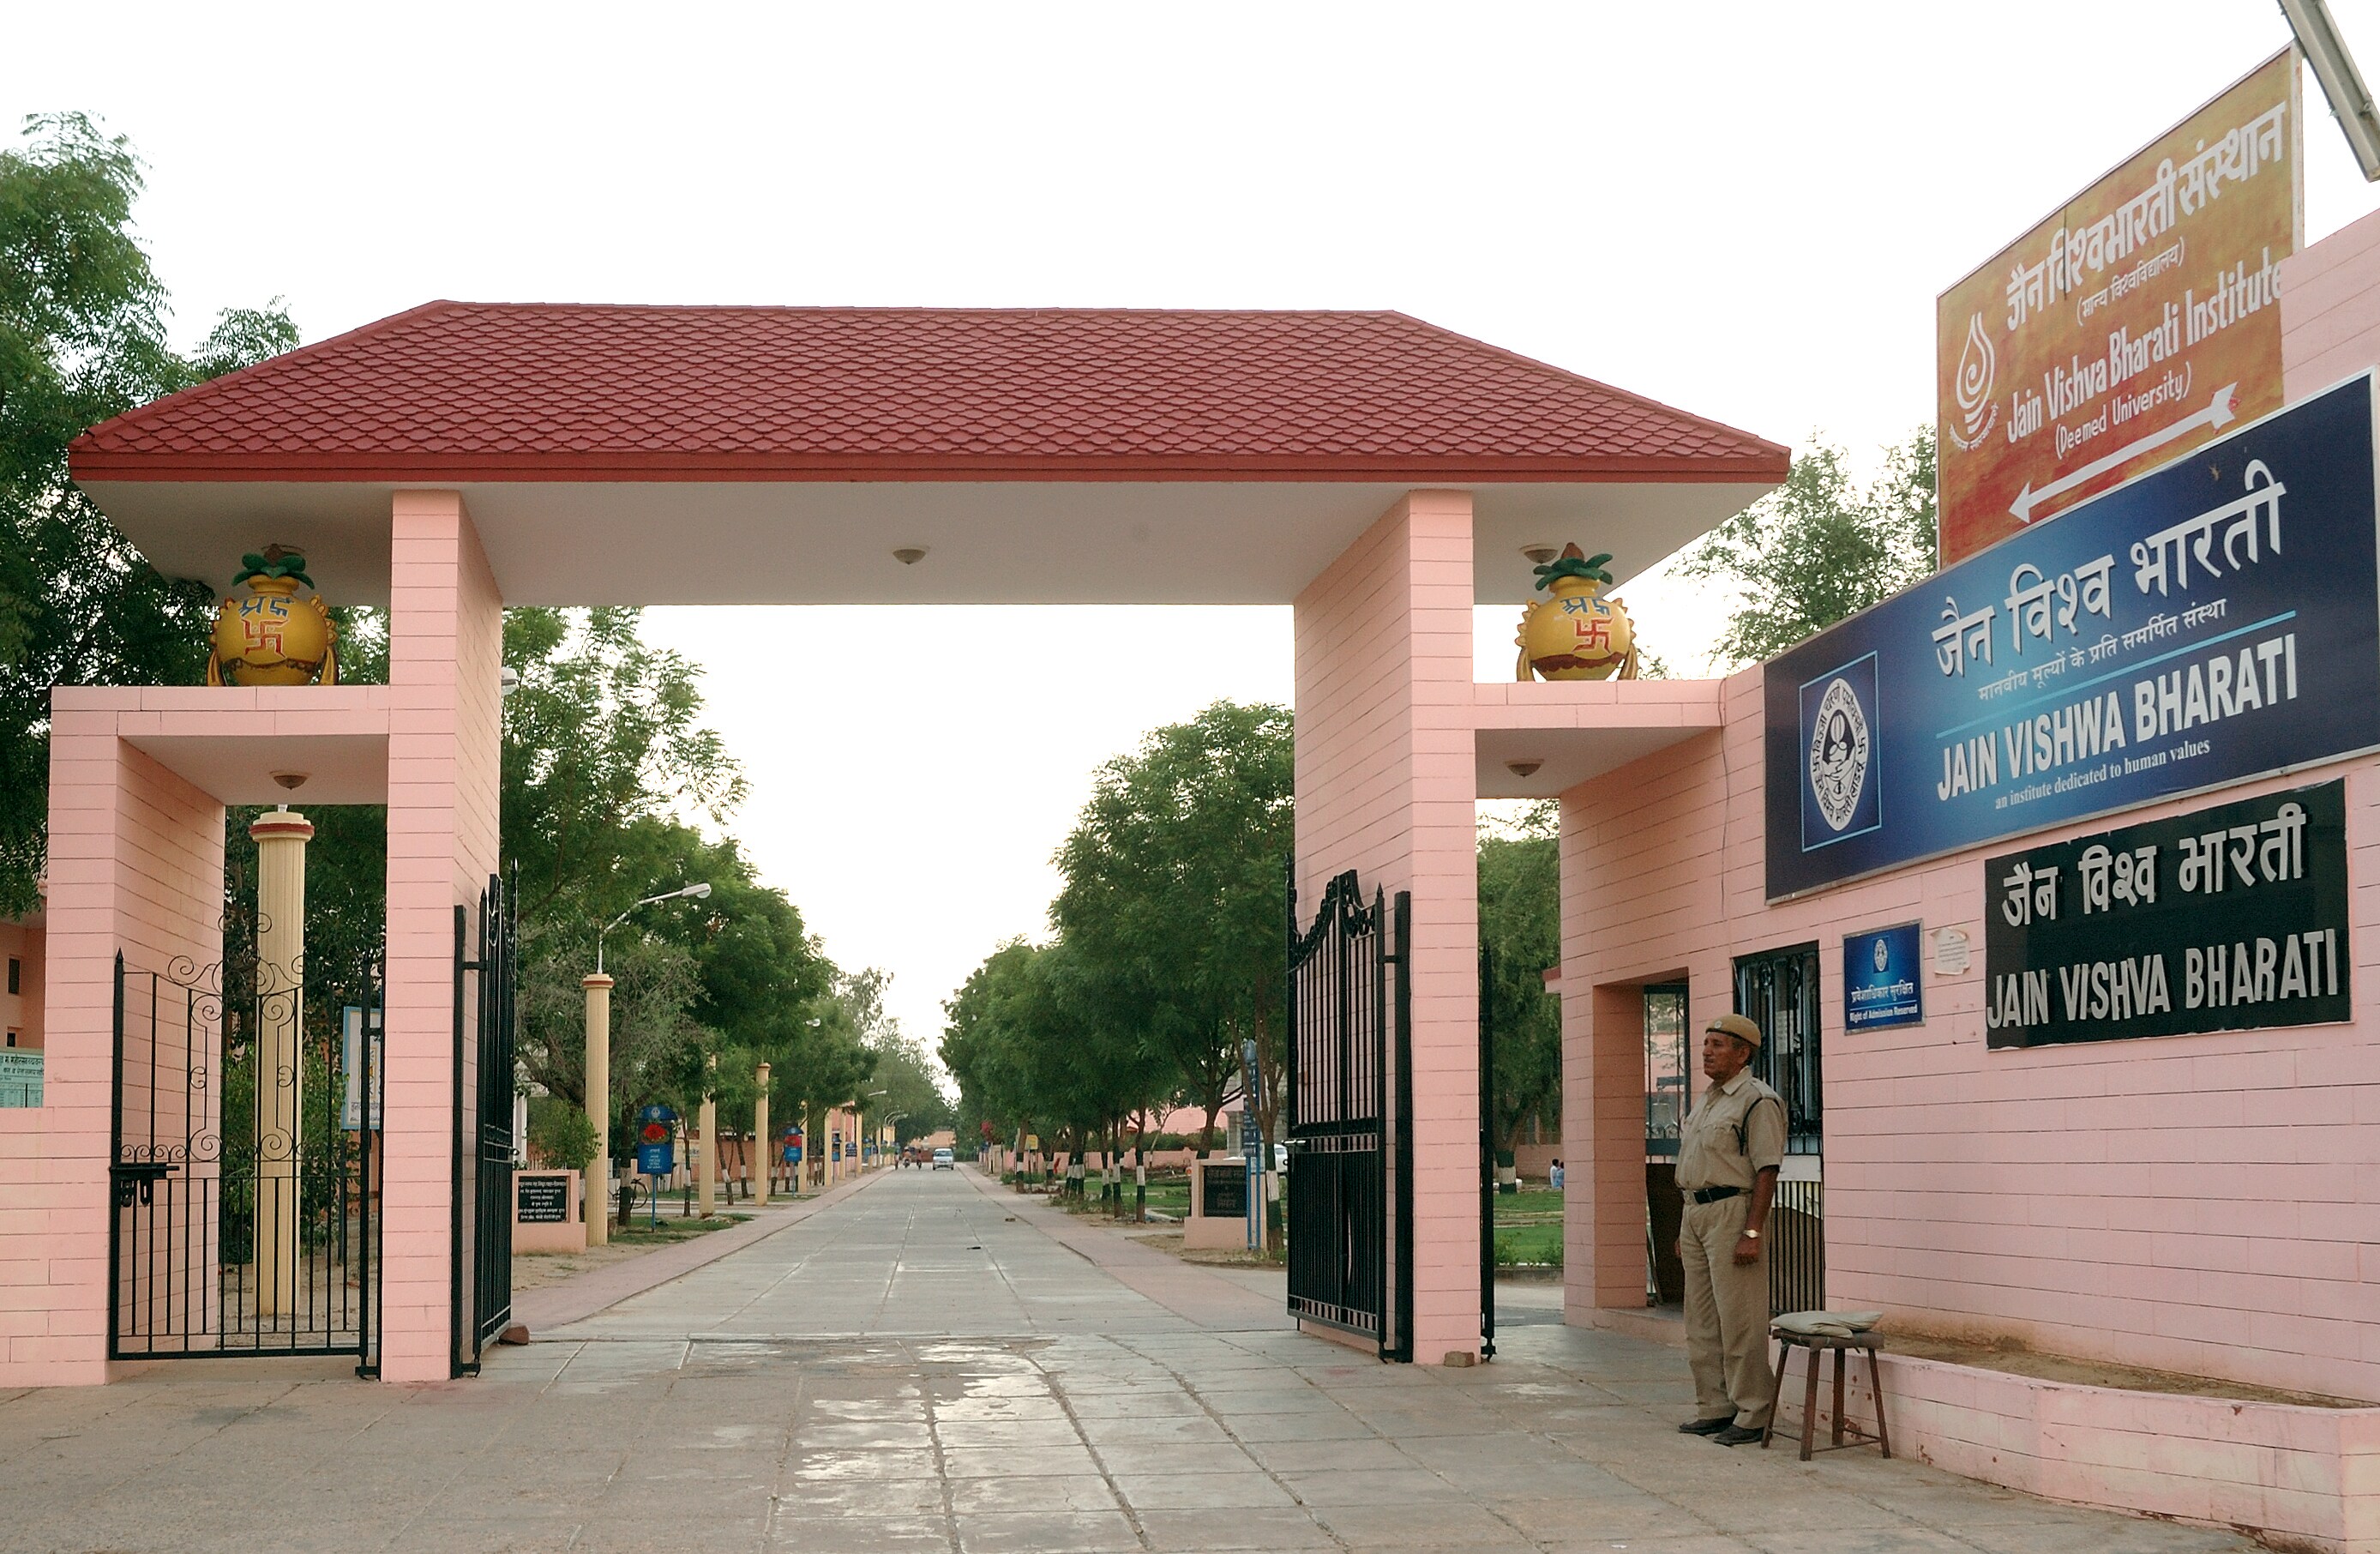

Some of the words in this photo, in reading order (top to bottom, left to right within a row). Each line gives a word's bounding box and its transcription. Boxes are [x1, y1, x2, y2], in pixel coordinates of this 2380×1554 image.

[2006, 259, 2046, 331] जैन
[2178, 100, 2286, 216] संस्थान
[2007, 388, 2042, 443] Jain
[2045, 355, 2107, 420] Vishva
[2109, 301, 2179, 388] Bharati
[2185, 246, 2282, 346] Institute
[2055, 413, 2107, 460] (Deemed
[2112, 361, 2191, 425] University)
[1931, 596, 1996, 678] जैन
[2004, 553, 2116, 655] विश्व
[2131, 458, 2287, 598] भारती
[1978, 671, 2028, 701] मानवीय
[2032, 652, 2066, 690] मूल्यों
[2069, 653, 2085, 669] के
[2089, 635, 2118, 664] प्रति
[2121, 612, 2178, 652] समर्पित
[2183, 598, 2227, 629] संस्था
[1937, 732, 1998, 801] JAIN
[2005, 691, 2126, 774] VISHWA
[2135, 633, 2298, 742] BHARATI
[1995, 797, 2009, 809] an
[2010, 781, 2052, 807] institute
[2054, 767, 2107, 793] dedicated
[2109, 765, 2121, 780] to
[2125, 753, 2167, 774] human
[2170, 738, 2211, 762] values
[2002, 860, 2058, 927] जैन
[2078, 844, 2157, 915] विश्व
[2179, 802, 2306, 894] भारती
[1986, 969, 2048, 1028] JAIN
[2059, 954, 2171, 1021] VISHVA
[2185, 929, 2338, 1009] BHARATI
